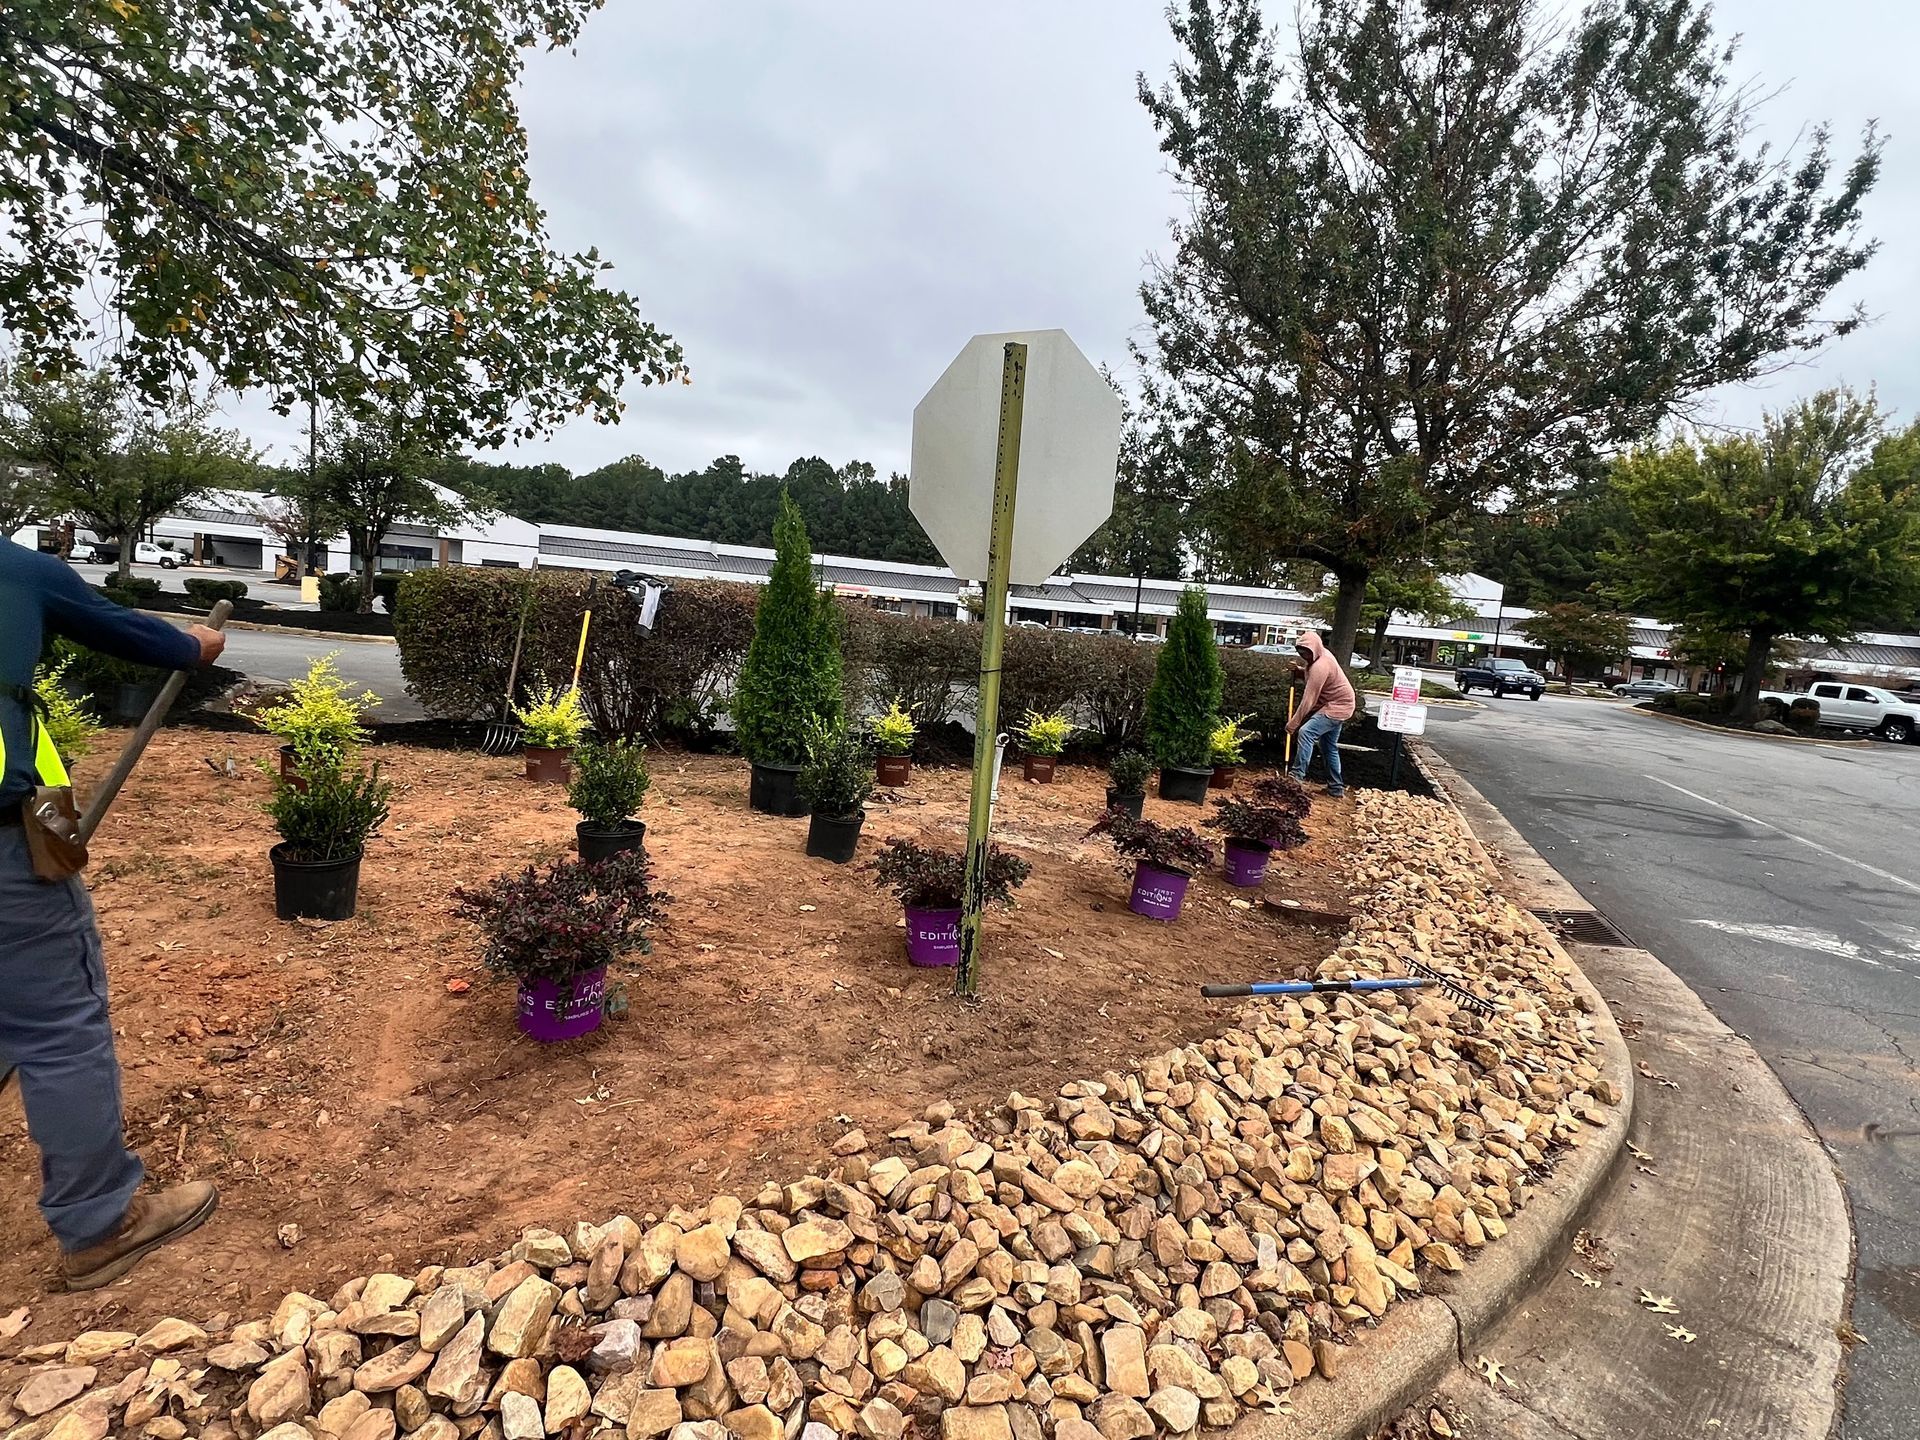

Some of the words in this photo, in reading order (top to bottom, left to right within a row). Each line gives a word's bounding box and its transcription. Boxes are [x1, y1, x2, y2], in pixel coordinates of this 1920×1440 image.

[1137, 888, 1172, 902] EDITIONS
[1154, 888, 1175, 896] FIRST
[583, 979, 604, 994] FIR
